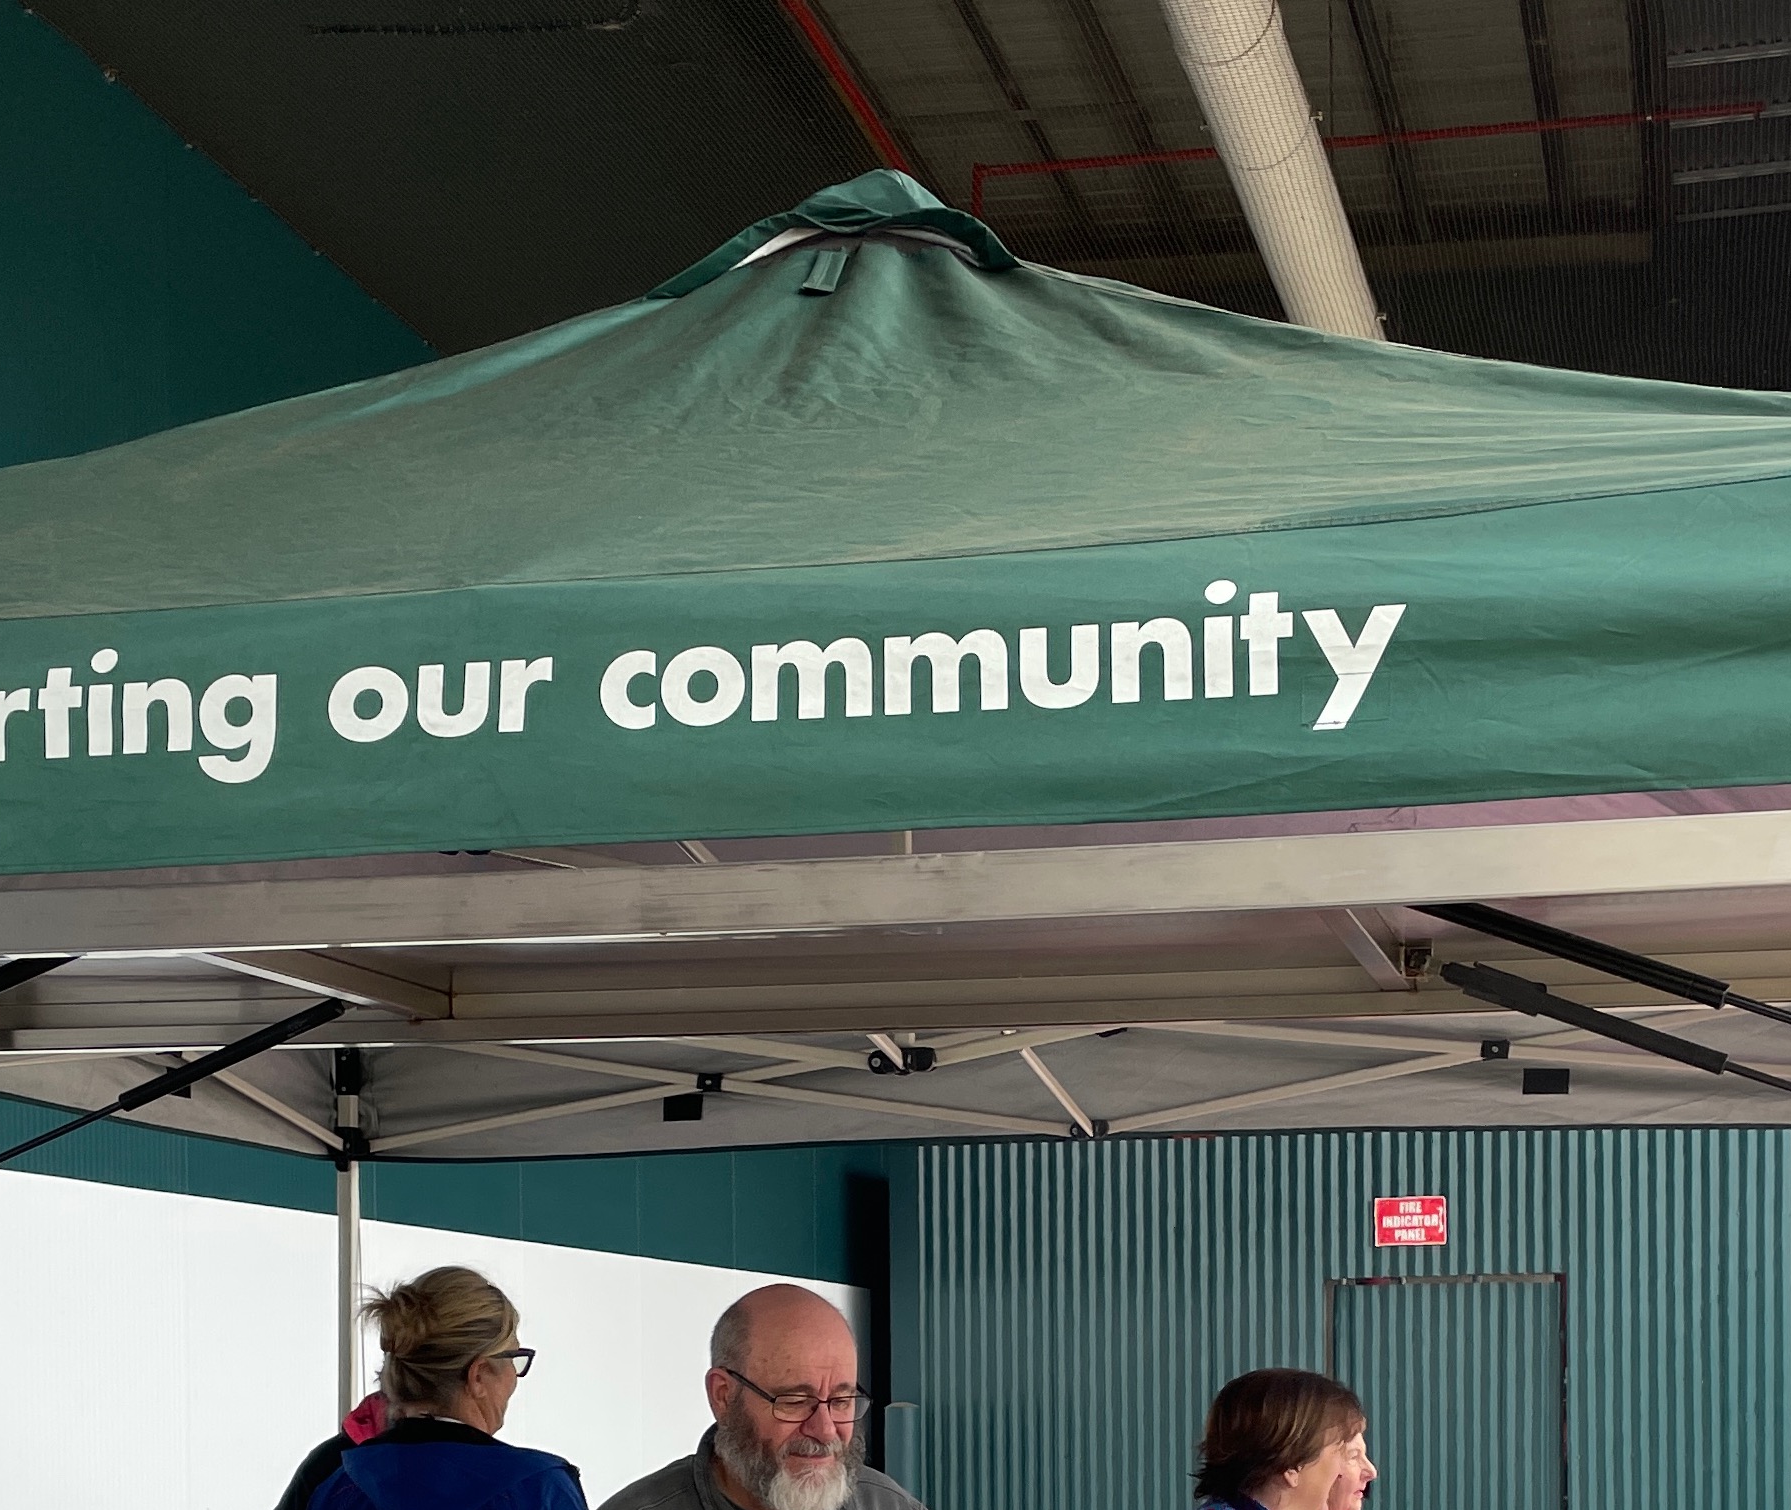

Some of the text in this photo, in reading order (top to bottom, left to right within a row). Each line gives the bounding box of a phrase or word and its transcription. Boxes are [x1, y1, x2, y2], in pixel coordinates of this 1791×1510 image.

[328, 658, 553, 744] our
[599, 579, 1408, 731] community
[1399, 1201, 1422, 1214] FIRE
[1382, 1214, 1439, 1228] INDICATOR
[1394, 1228, 1426, 1241] PANEL
